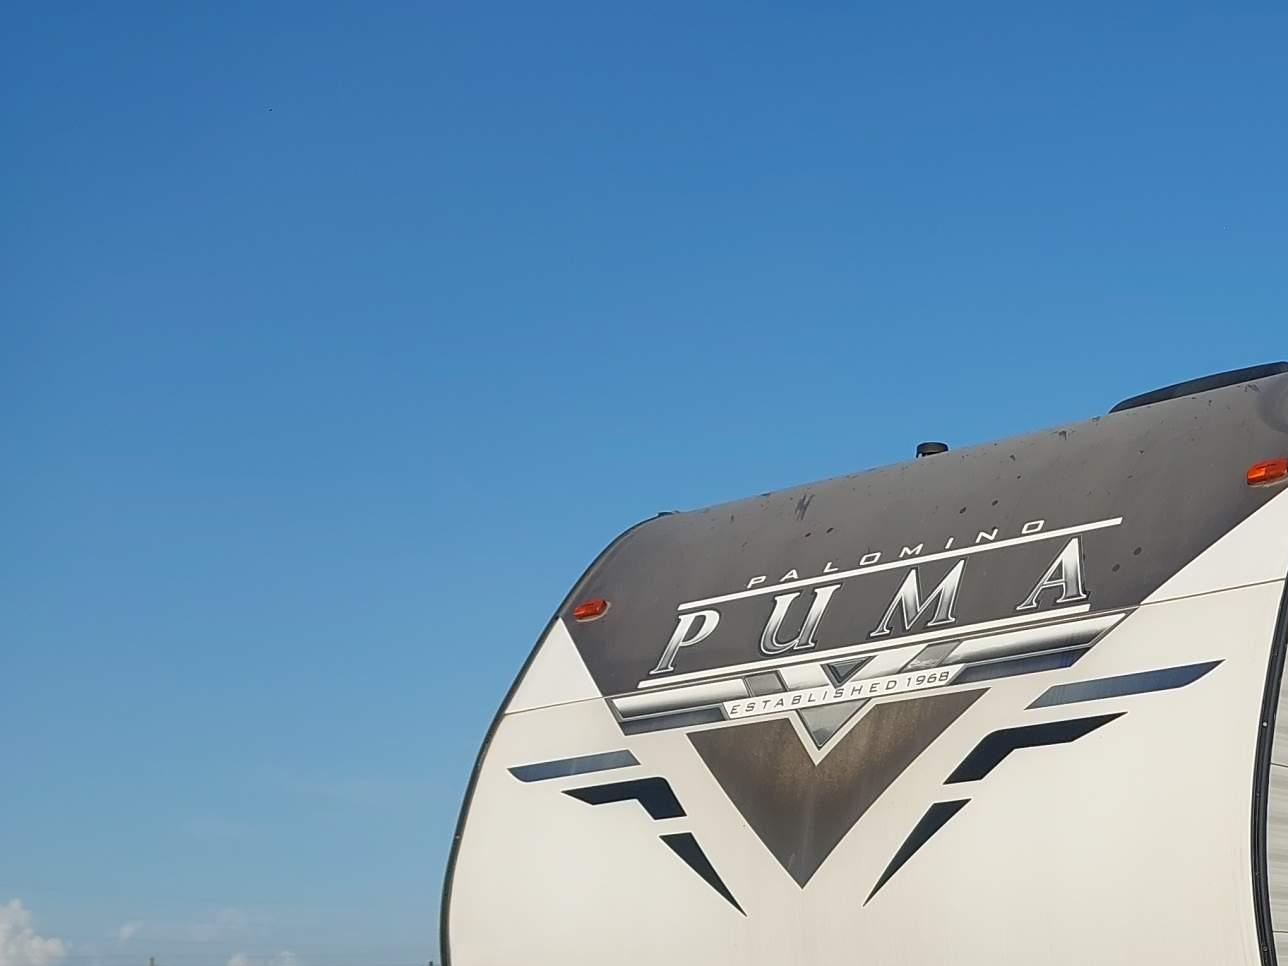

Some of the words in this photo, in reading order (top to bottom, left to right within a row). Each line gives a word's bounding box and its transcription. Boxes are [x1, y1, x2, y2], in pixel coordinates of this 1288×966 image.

[746, 518, 1046, 589] PALOMINO
[648, 535, 1091, 676] PUMA
[729, 678, 898, 716] ESTABLISHED
[905, 669, 951, 689] 1968
